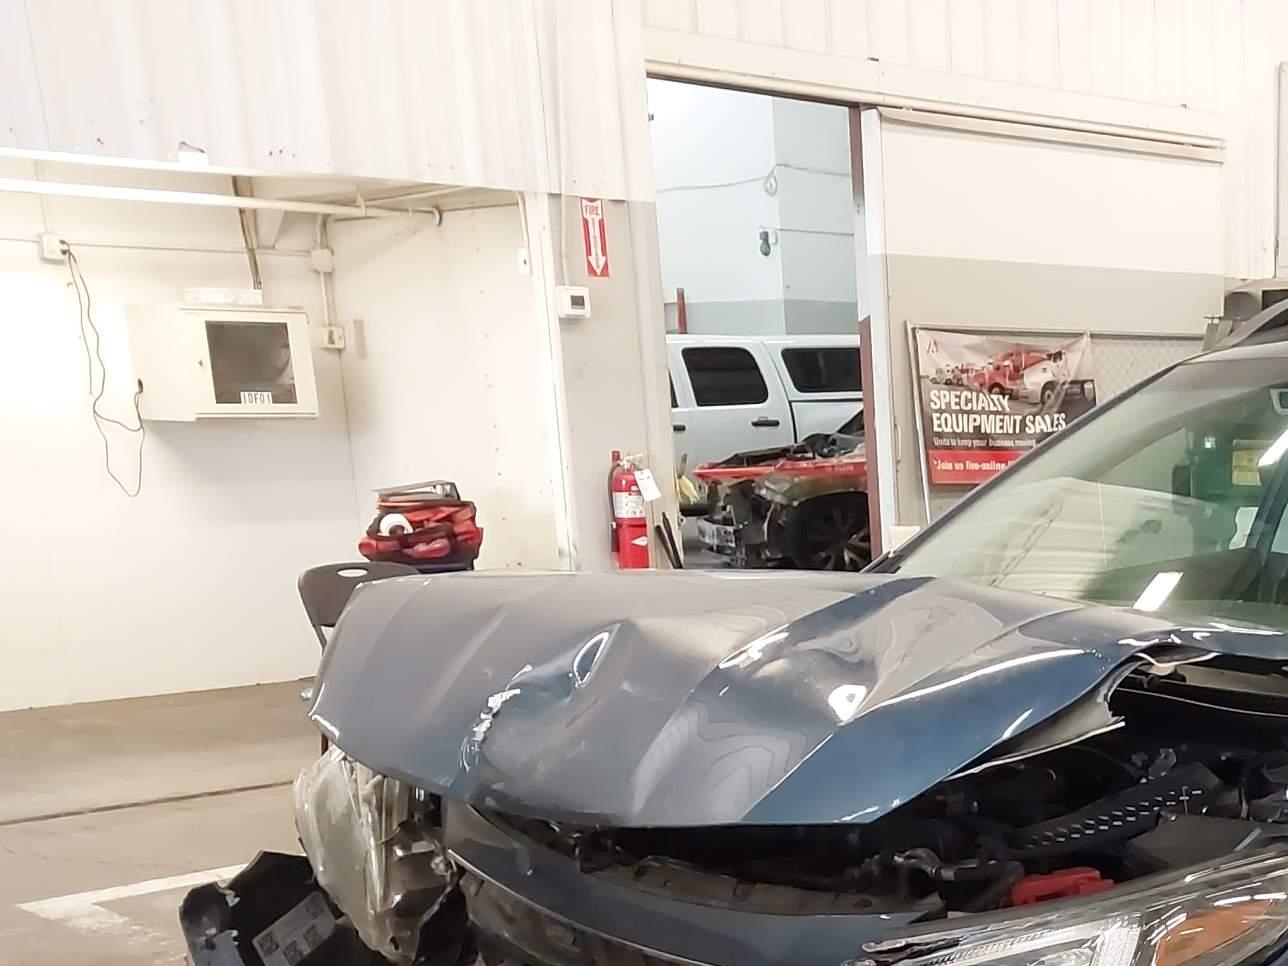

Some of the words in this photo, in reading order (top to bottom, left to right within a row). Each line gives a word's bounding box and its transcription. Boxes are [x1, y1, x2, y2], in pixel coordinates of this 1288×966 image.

[930, 390, 1010, 412] SPECIALTY
[932, 413, 1022, 433] EQUIPMENT
[1025, 413, 1066, 433] SALES
